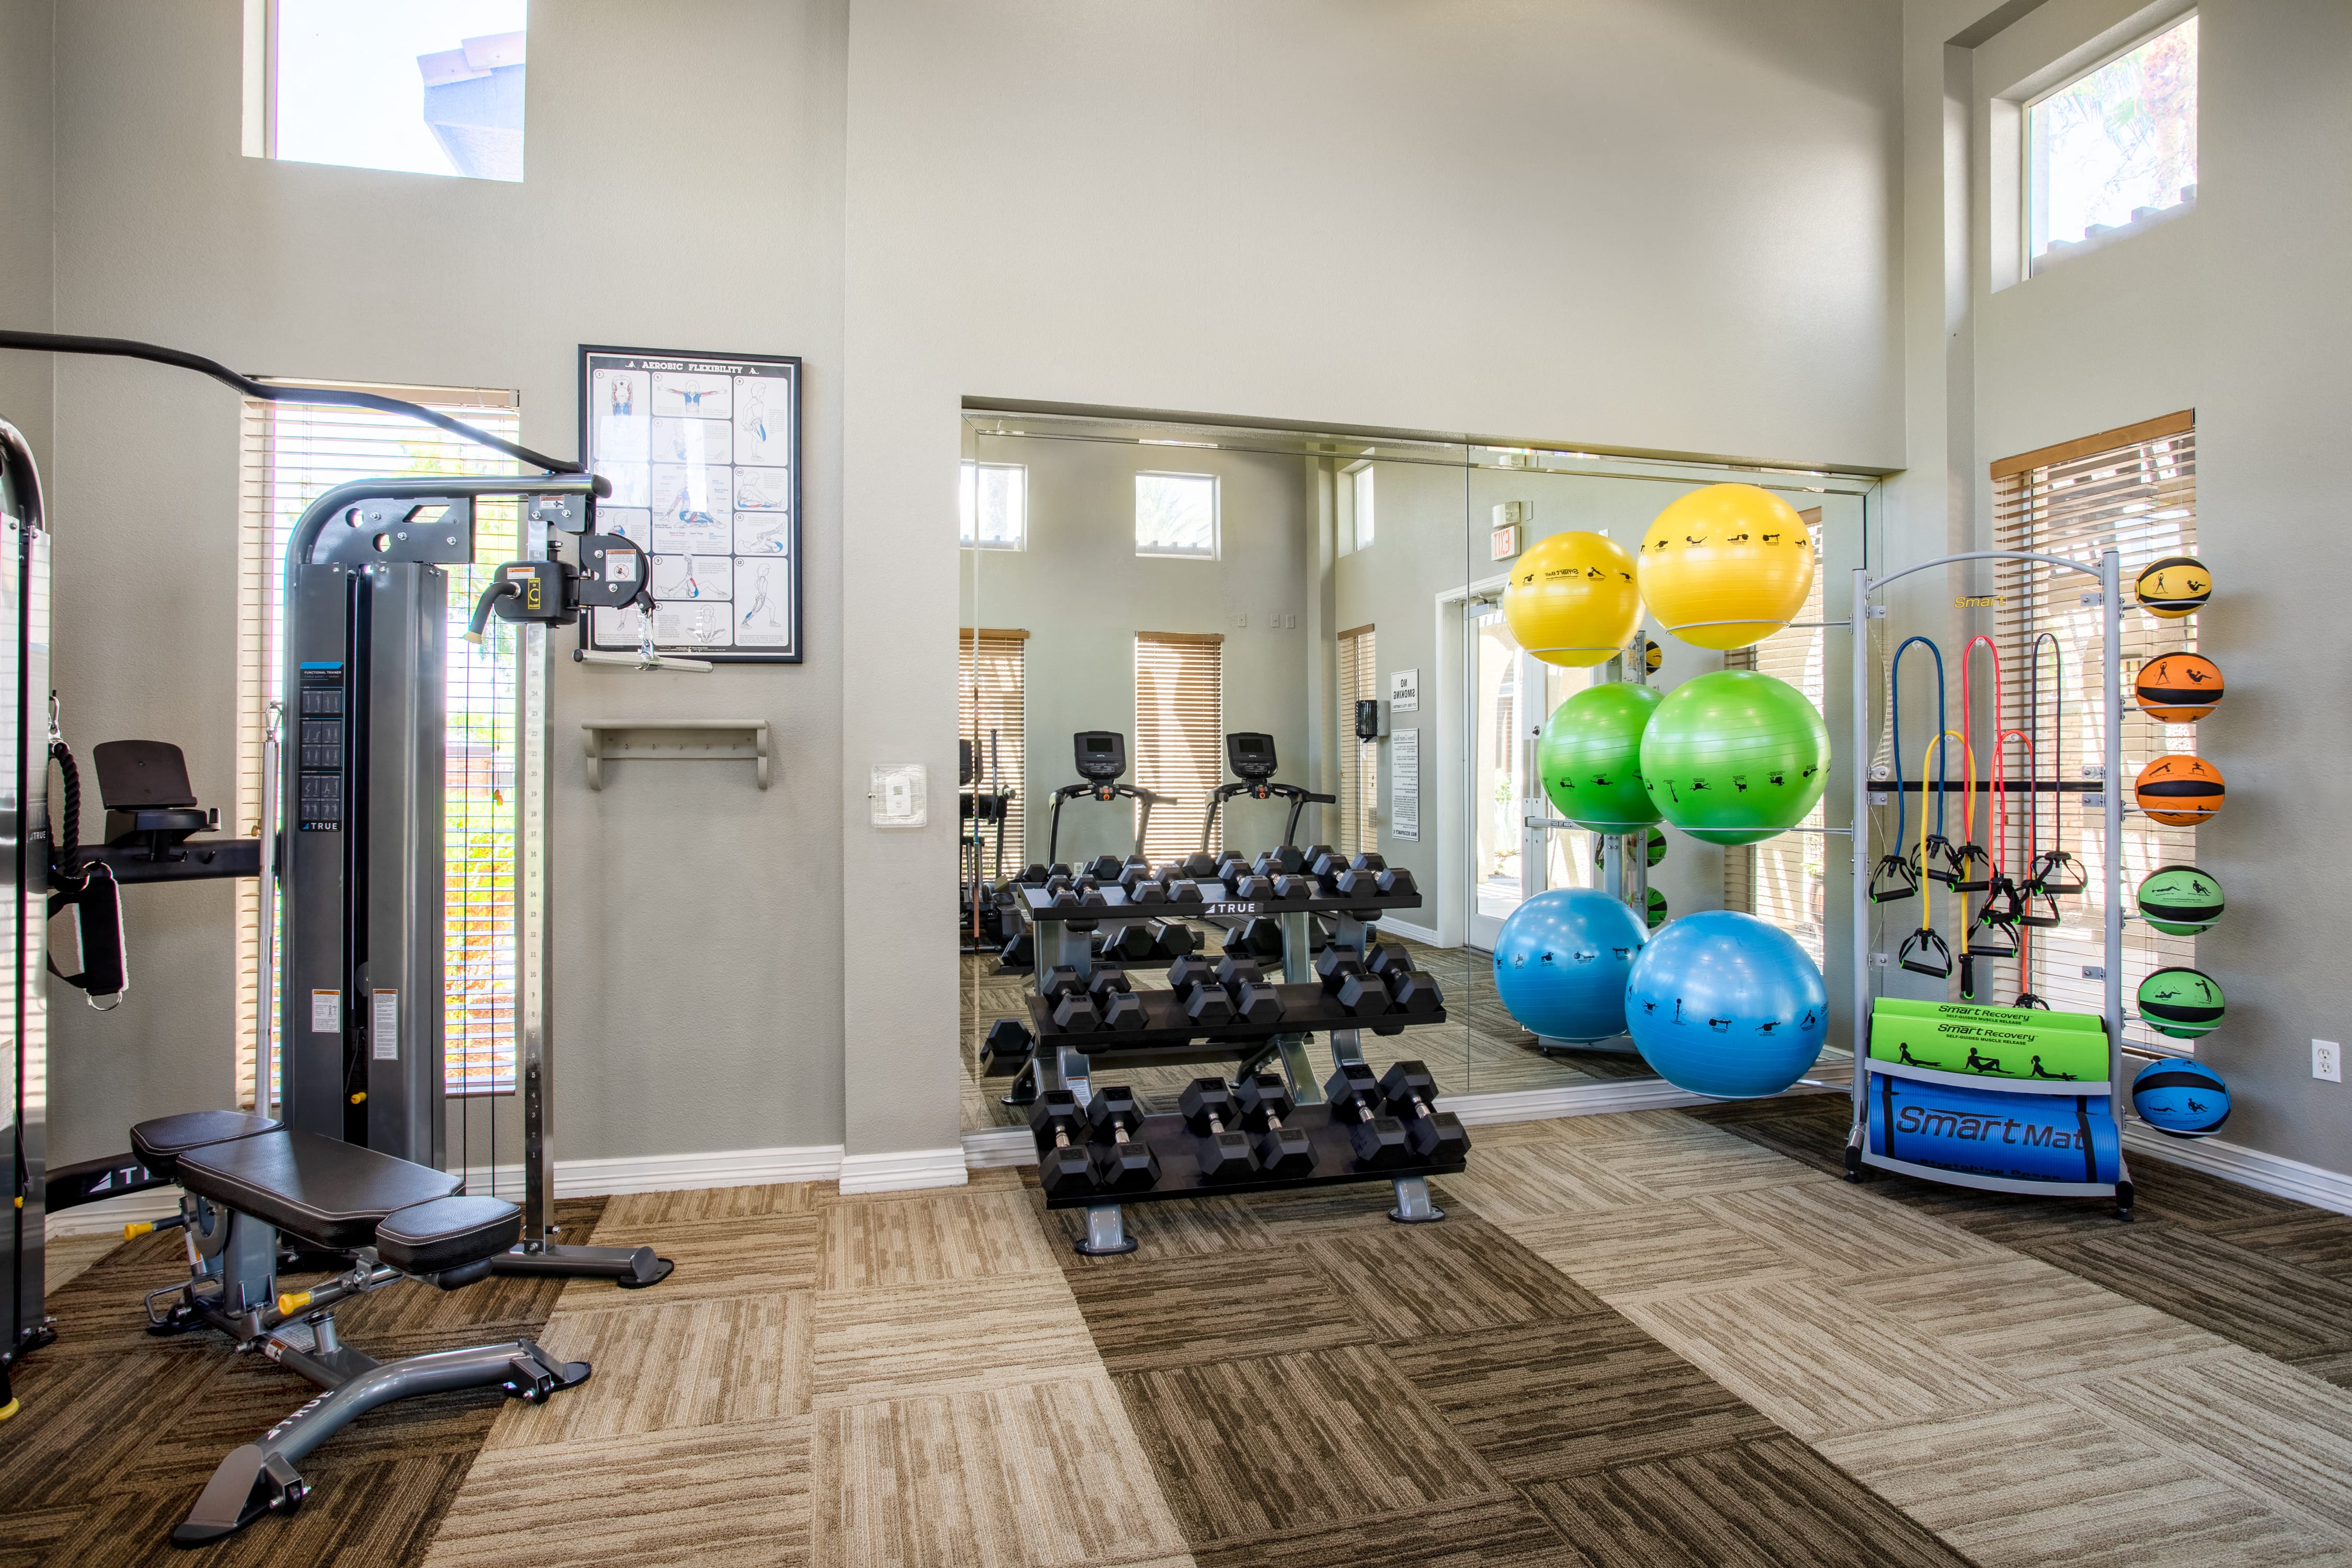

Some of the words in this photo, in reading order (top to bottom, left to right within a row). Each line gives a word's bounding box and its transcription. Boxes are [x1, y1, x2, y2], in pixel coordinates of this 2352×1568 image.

[642, 361, 684, 371] AEROBIC
[688, 363, 743, 374] FLEXIBILITY
[1954, 594, 2007, 608] Smart
[1217, 904, 1255, 913] TRUE
[1938, 1005, 1981, 1016] Smart
[1982, 1010, 2030, 1022] Recovery
[1938, 1023, 1984, 1036] Smart
[1984, 1029, 2035, 1042] Recovery
[1896, 1105, 2021, 1145] Smart
[2023, 1124, 2084, 1150] Mat
[1065, 1150, 1079, 1158] 40
[1127, 1144, 1140, 1154] 40
[1919, 1158, 2004, 1175] Stretching
[2010, 1169, 2061, 1180] Poses
[283, 1389, 336, 1426] TRUE
